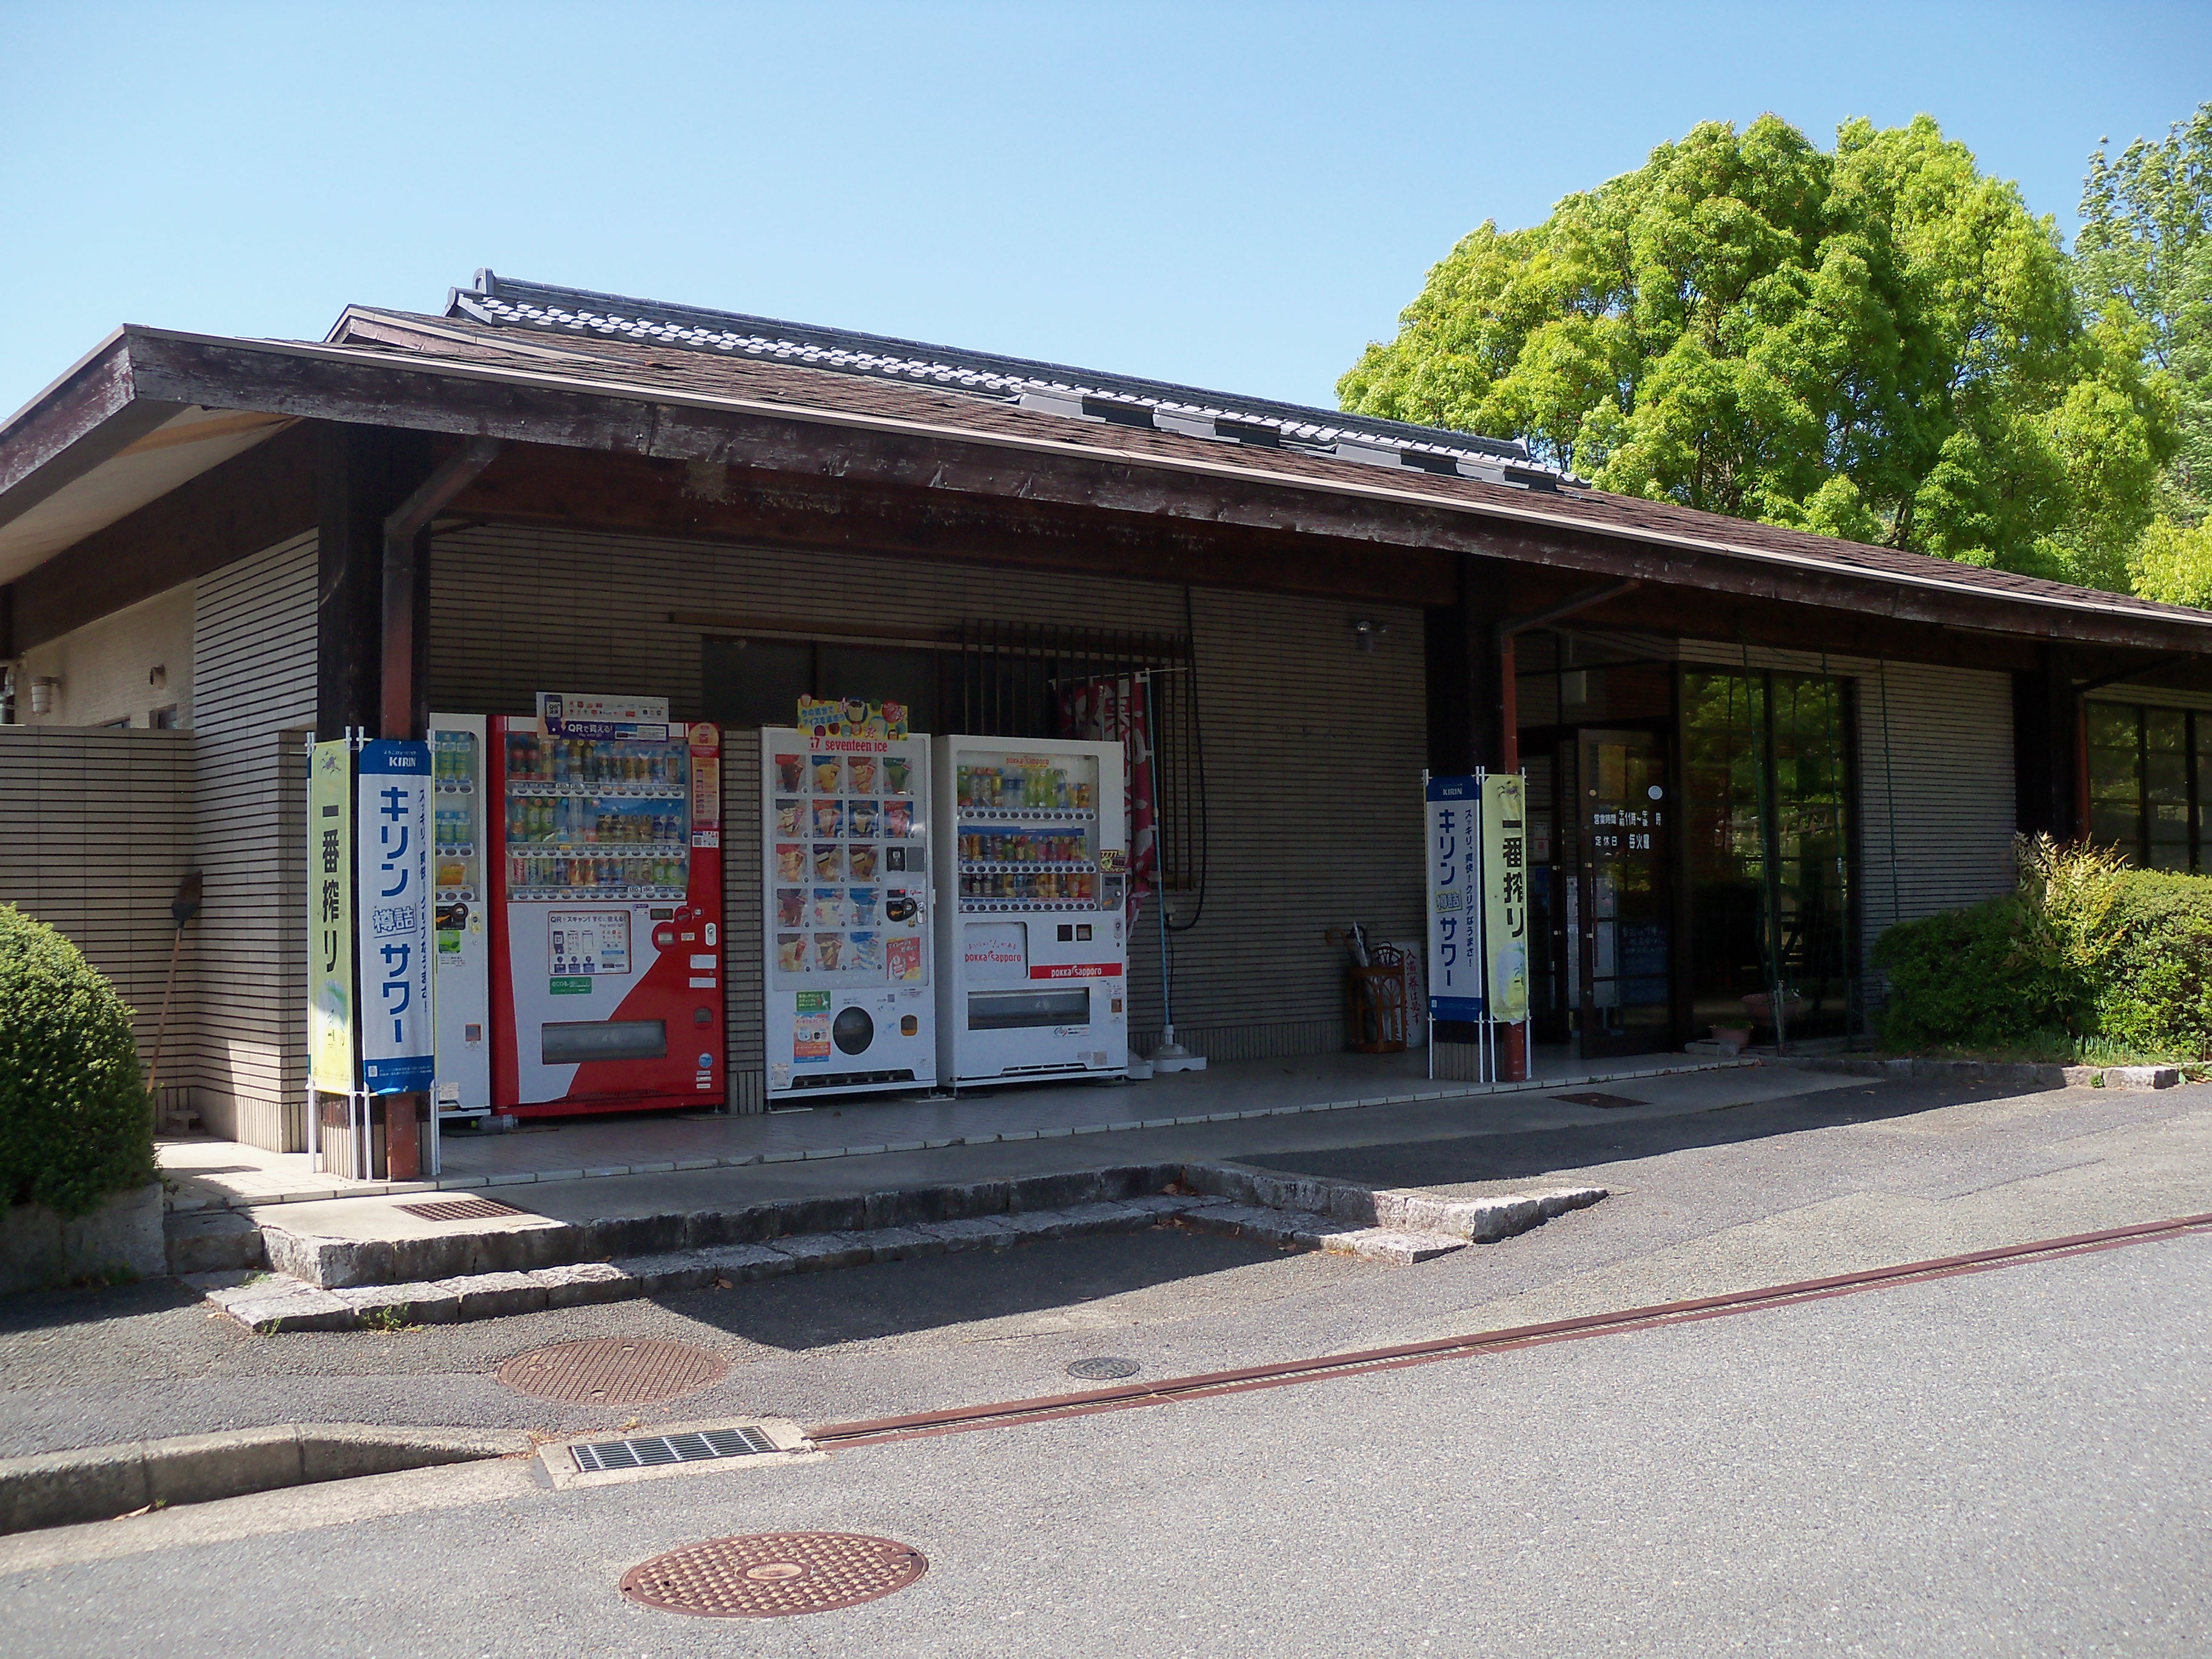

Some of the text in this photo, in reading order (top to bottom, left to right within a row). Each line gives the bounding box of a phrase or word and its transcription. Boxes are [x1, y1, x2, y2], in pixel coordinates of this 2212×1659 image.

[825, 739, 872, 752] seventeen
[874, 739, 888, 752] ice
[389, 756, 416, 767] KIRIN
[1443, 788, 1463, 796] KIRIN
[1595, 835, 1618, 846] 定休日
[1503, 820, 1524, 938] 一番搾り
[322, 804, 340, 973] 一番搾り
